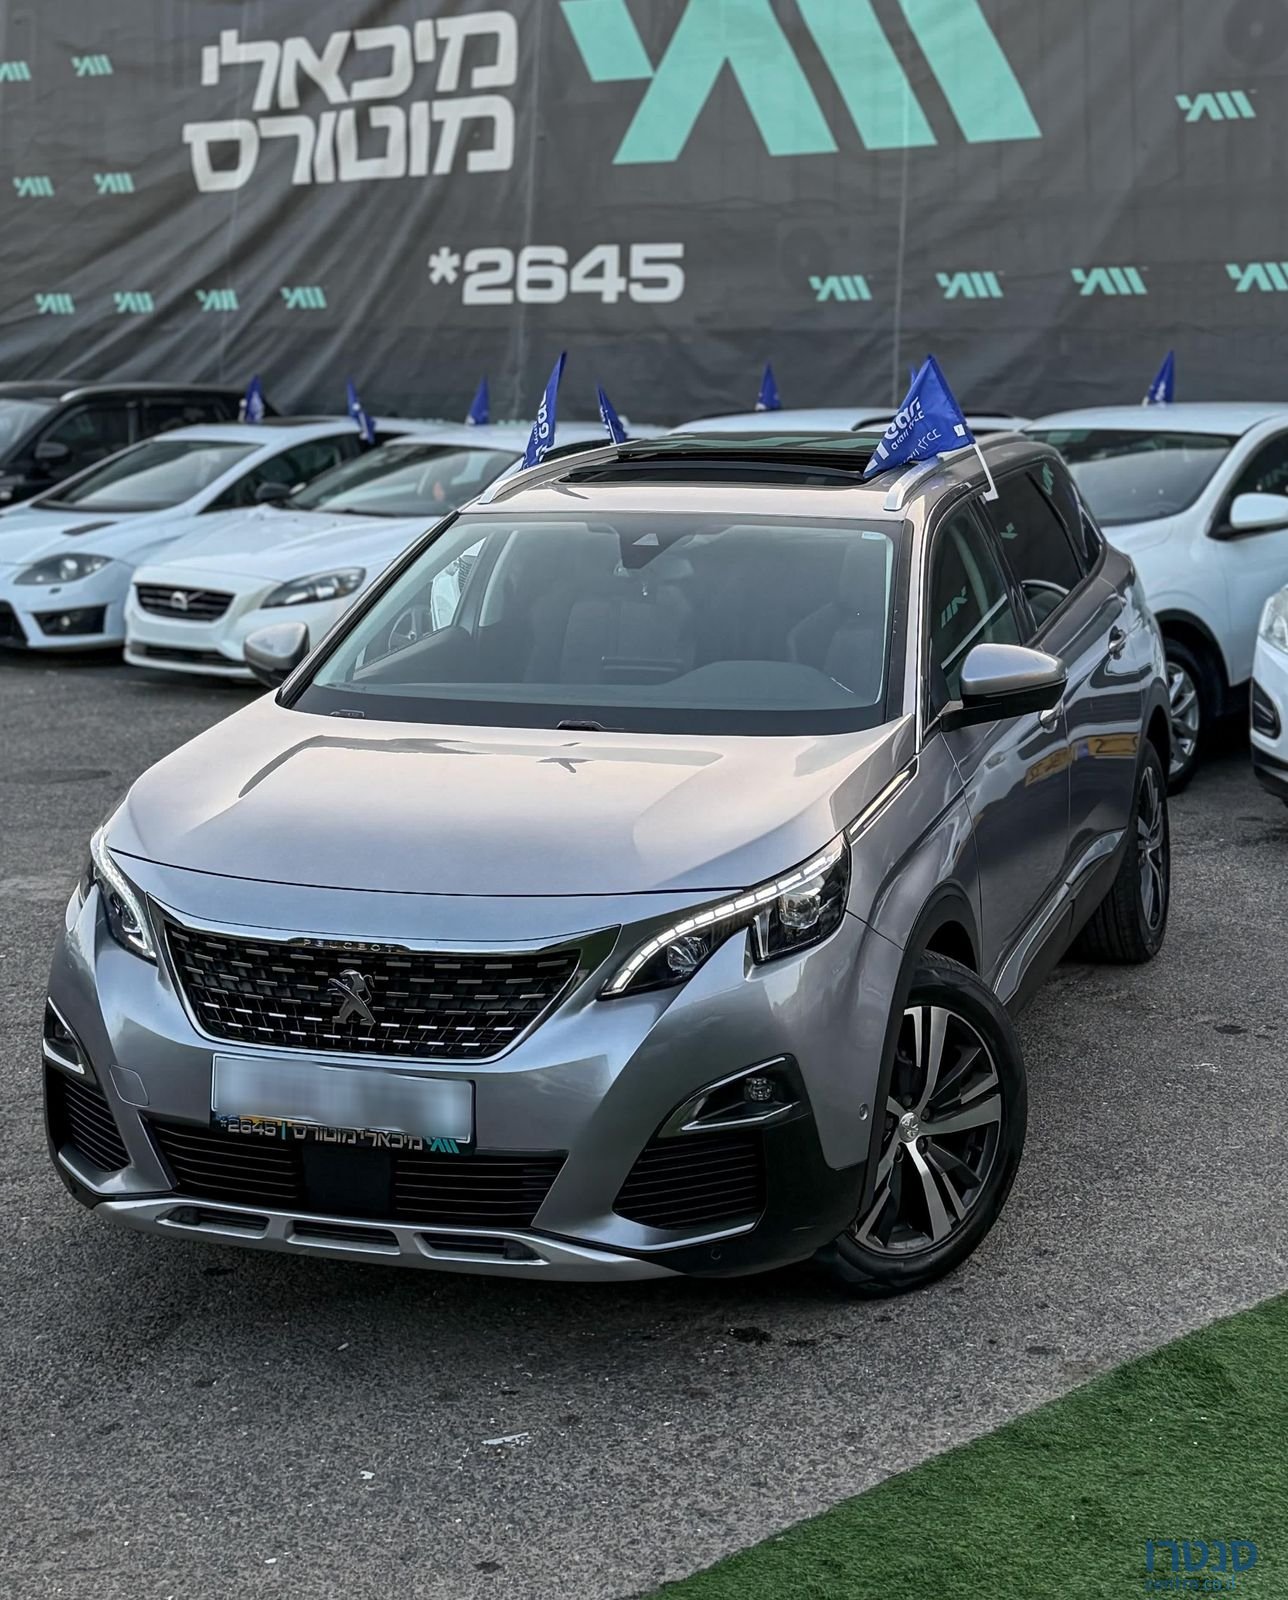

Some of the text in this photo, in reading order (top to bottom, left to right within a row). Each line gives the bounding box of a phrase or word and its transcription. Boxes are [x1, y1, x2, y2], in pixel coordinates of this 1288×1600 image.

[202, 11, 518, 112] מיכאלי
[182, 94, 515, 192] מוטורס
[291, 1124, 357, 1145] מוטורס
[360, 1130, 423, 1151] מיכאלי
